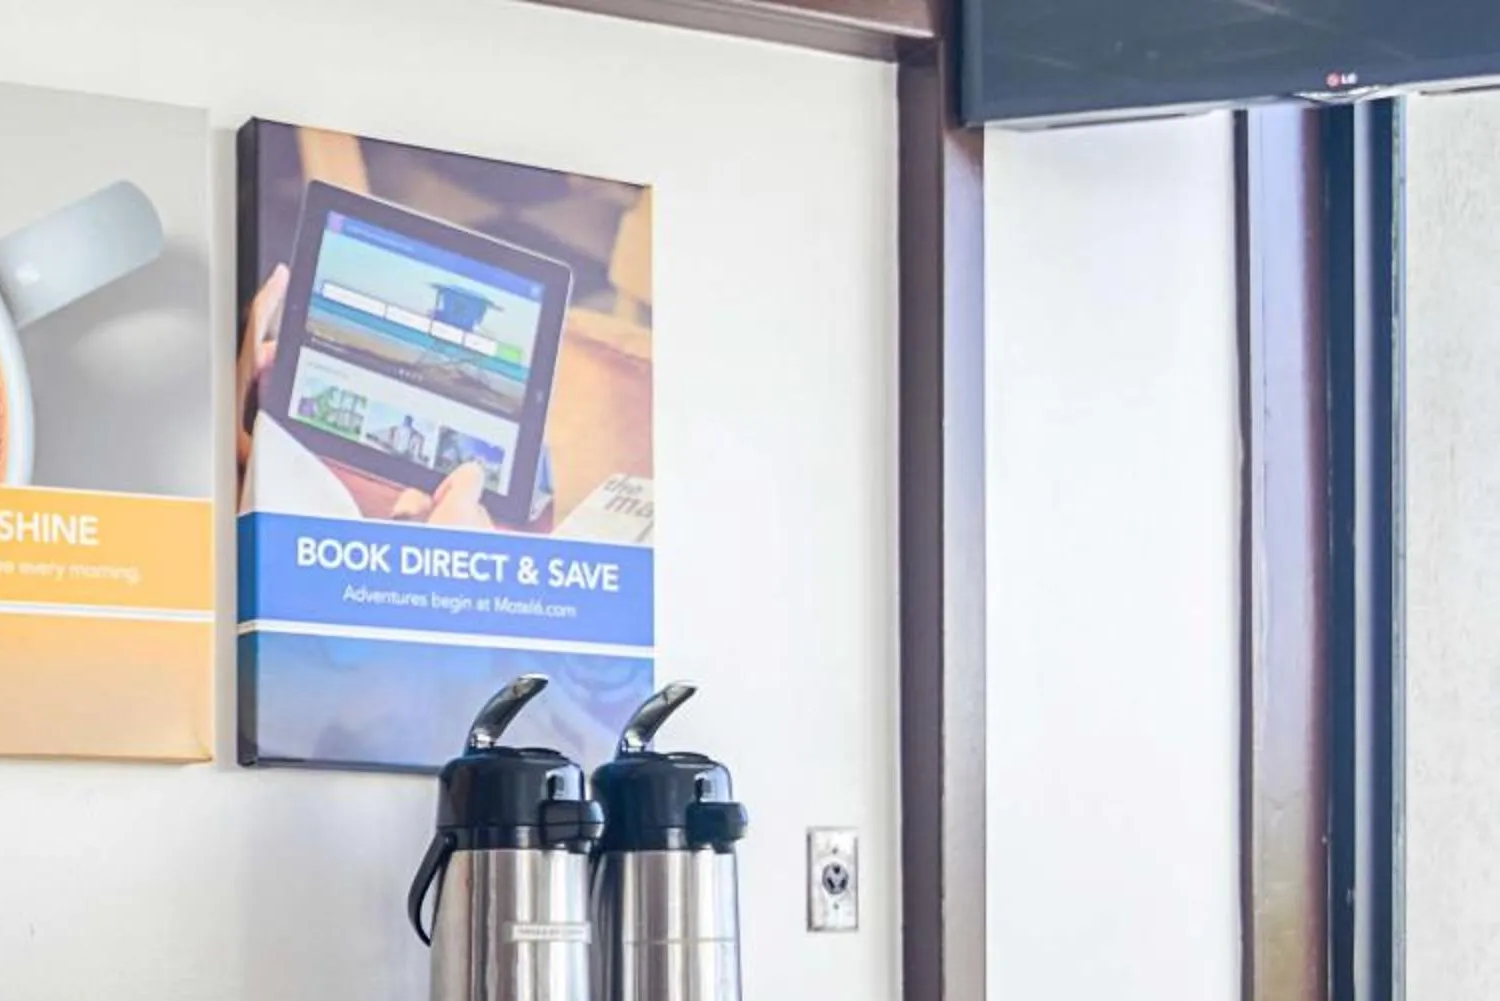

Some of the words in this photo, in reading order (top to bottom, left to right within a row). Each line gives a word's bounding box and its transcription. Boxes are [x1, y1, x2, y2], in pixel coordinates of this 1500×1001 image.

[296, 535, 392, 574] BOOK
[400, 544, 510, 584] DIRECT
[516, 554, 540, 587] &
[547, 557, 620, 593] SAVE
[342, 583, 428, 608] Adventures
[431, 591, 473, 615] begin
[475, 597, 492, 613] at
[494, 597, 577, 619] Motel6.com
